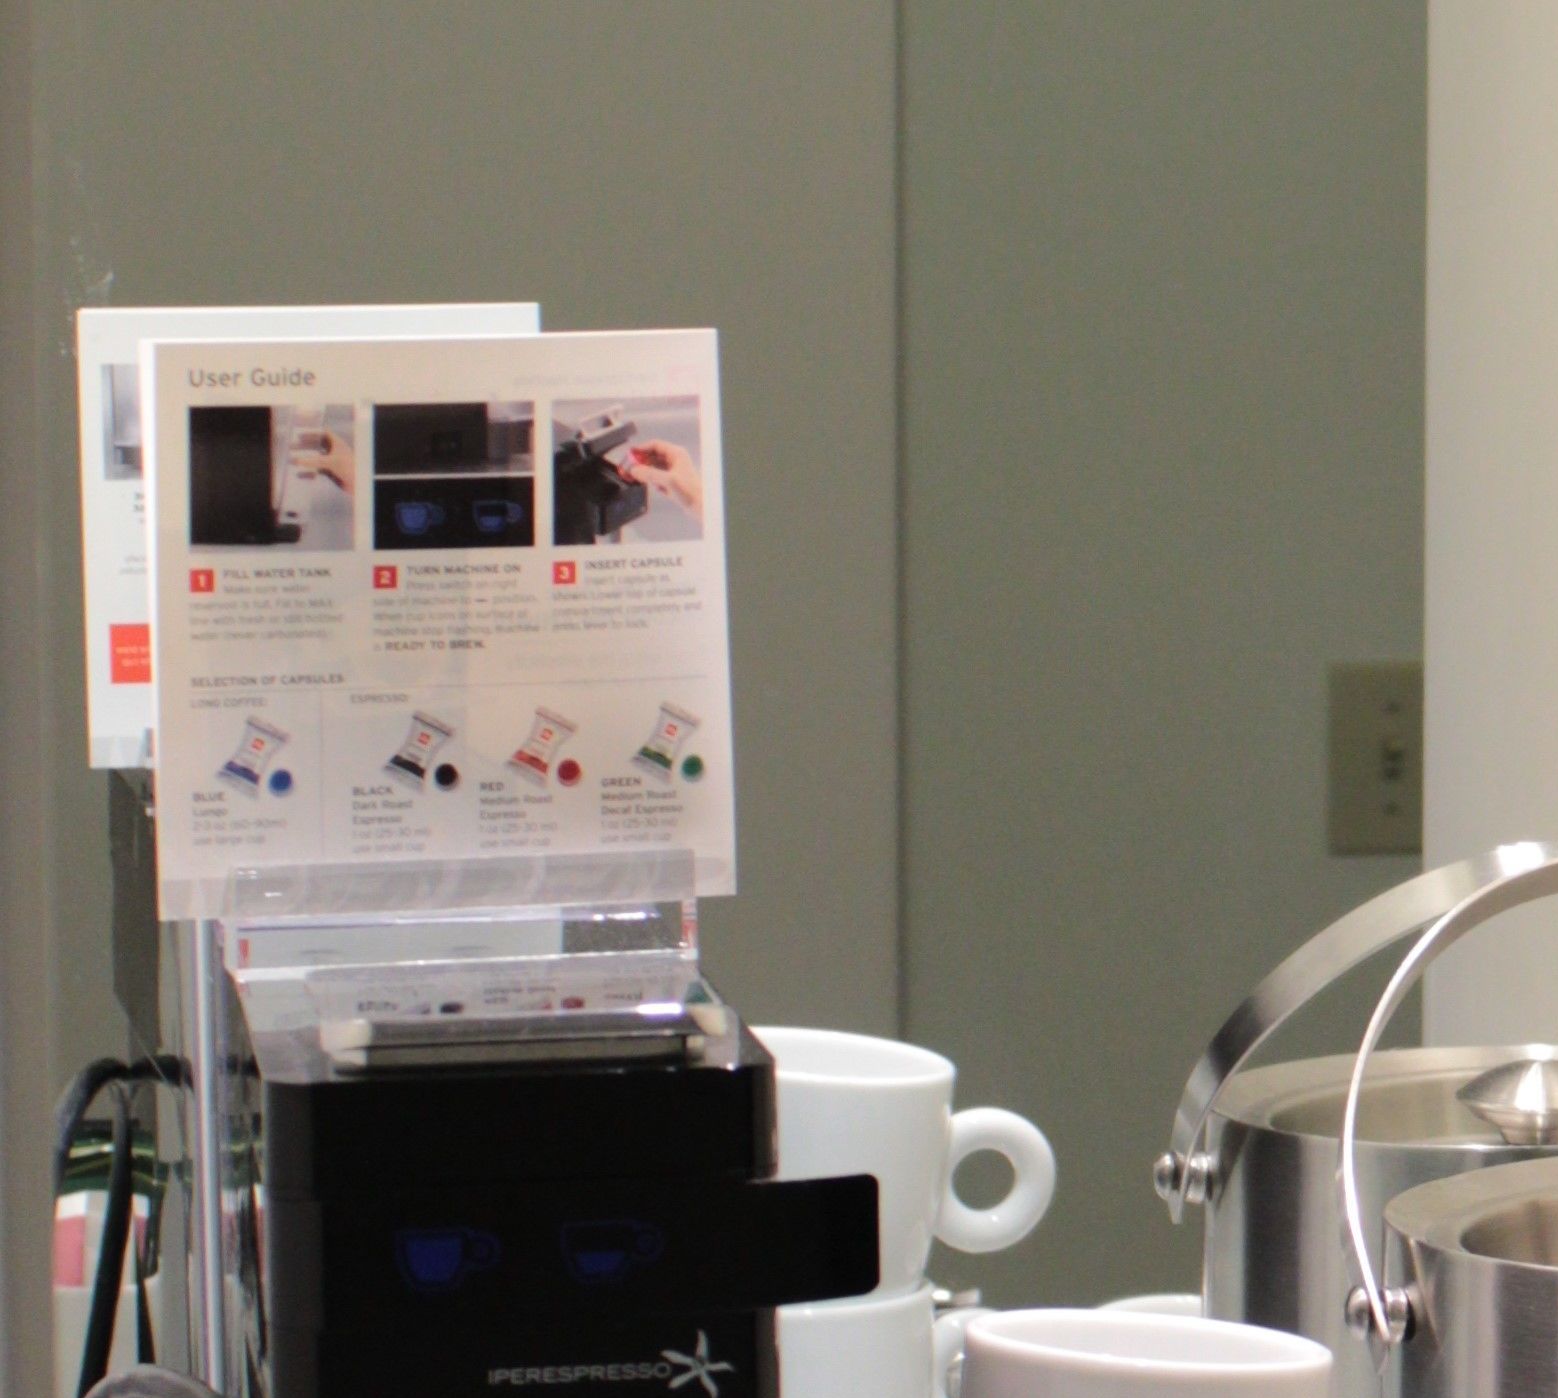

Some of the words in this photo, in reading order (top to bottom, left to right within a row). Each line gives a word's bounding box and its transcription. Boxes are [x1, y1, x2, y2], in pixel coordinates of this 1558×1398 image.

[188, 368, 241, 388] User
[251, 368, 316, 387] Guide
[584, 559, 626, 570] INSERT
[630, 556, 683, 568] CAPSULE
[223, 568, 250, 579] FILL
[254, 568, 296, 578] WATER
[298, 568, 332, 577] TANK
[407, 565, 440, 575] TURN
[444, 564, 499, 574] MACHINE
[503, 564, 521, 573] ON
[384, 641, 425, 651] READY
[430, 640, 446, 649] TO
[191, 676, 258, 687] SELECTION
[261, 675, 276, 685] OF
[279, 673, 345, 685] CAPSULES
[480, 782, 504, 791] RED
[600, 777, 642, 788] GREEN
[352, 786, 394, 796] BLACK
[192, 792, 225, 802] BLUE
[635, 804, 683, 814] Espresso
[352, 815, 402, 825] Espresso
[487, 1362, 672, 1385] IPERESPRESSO
